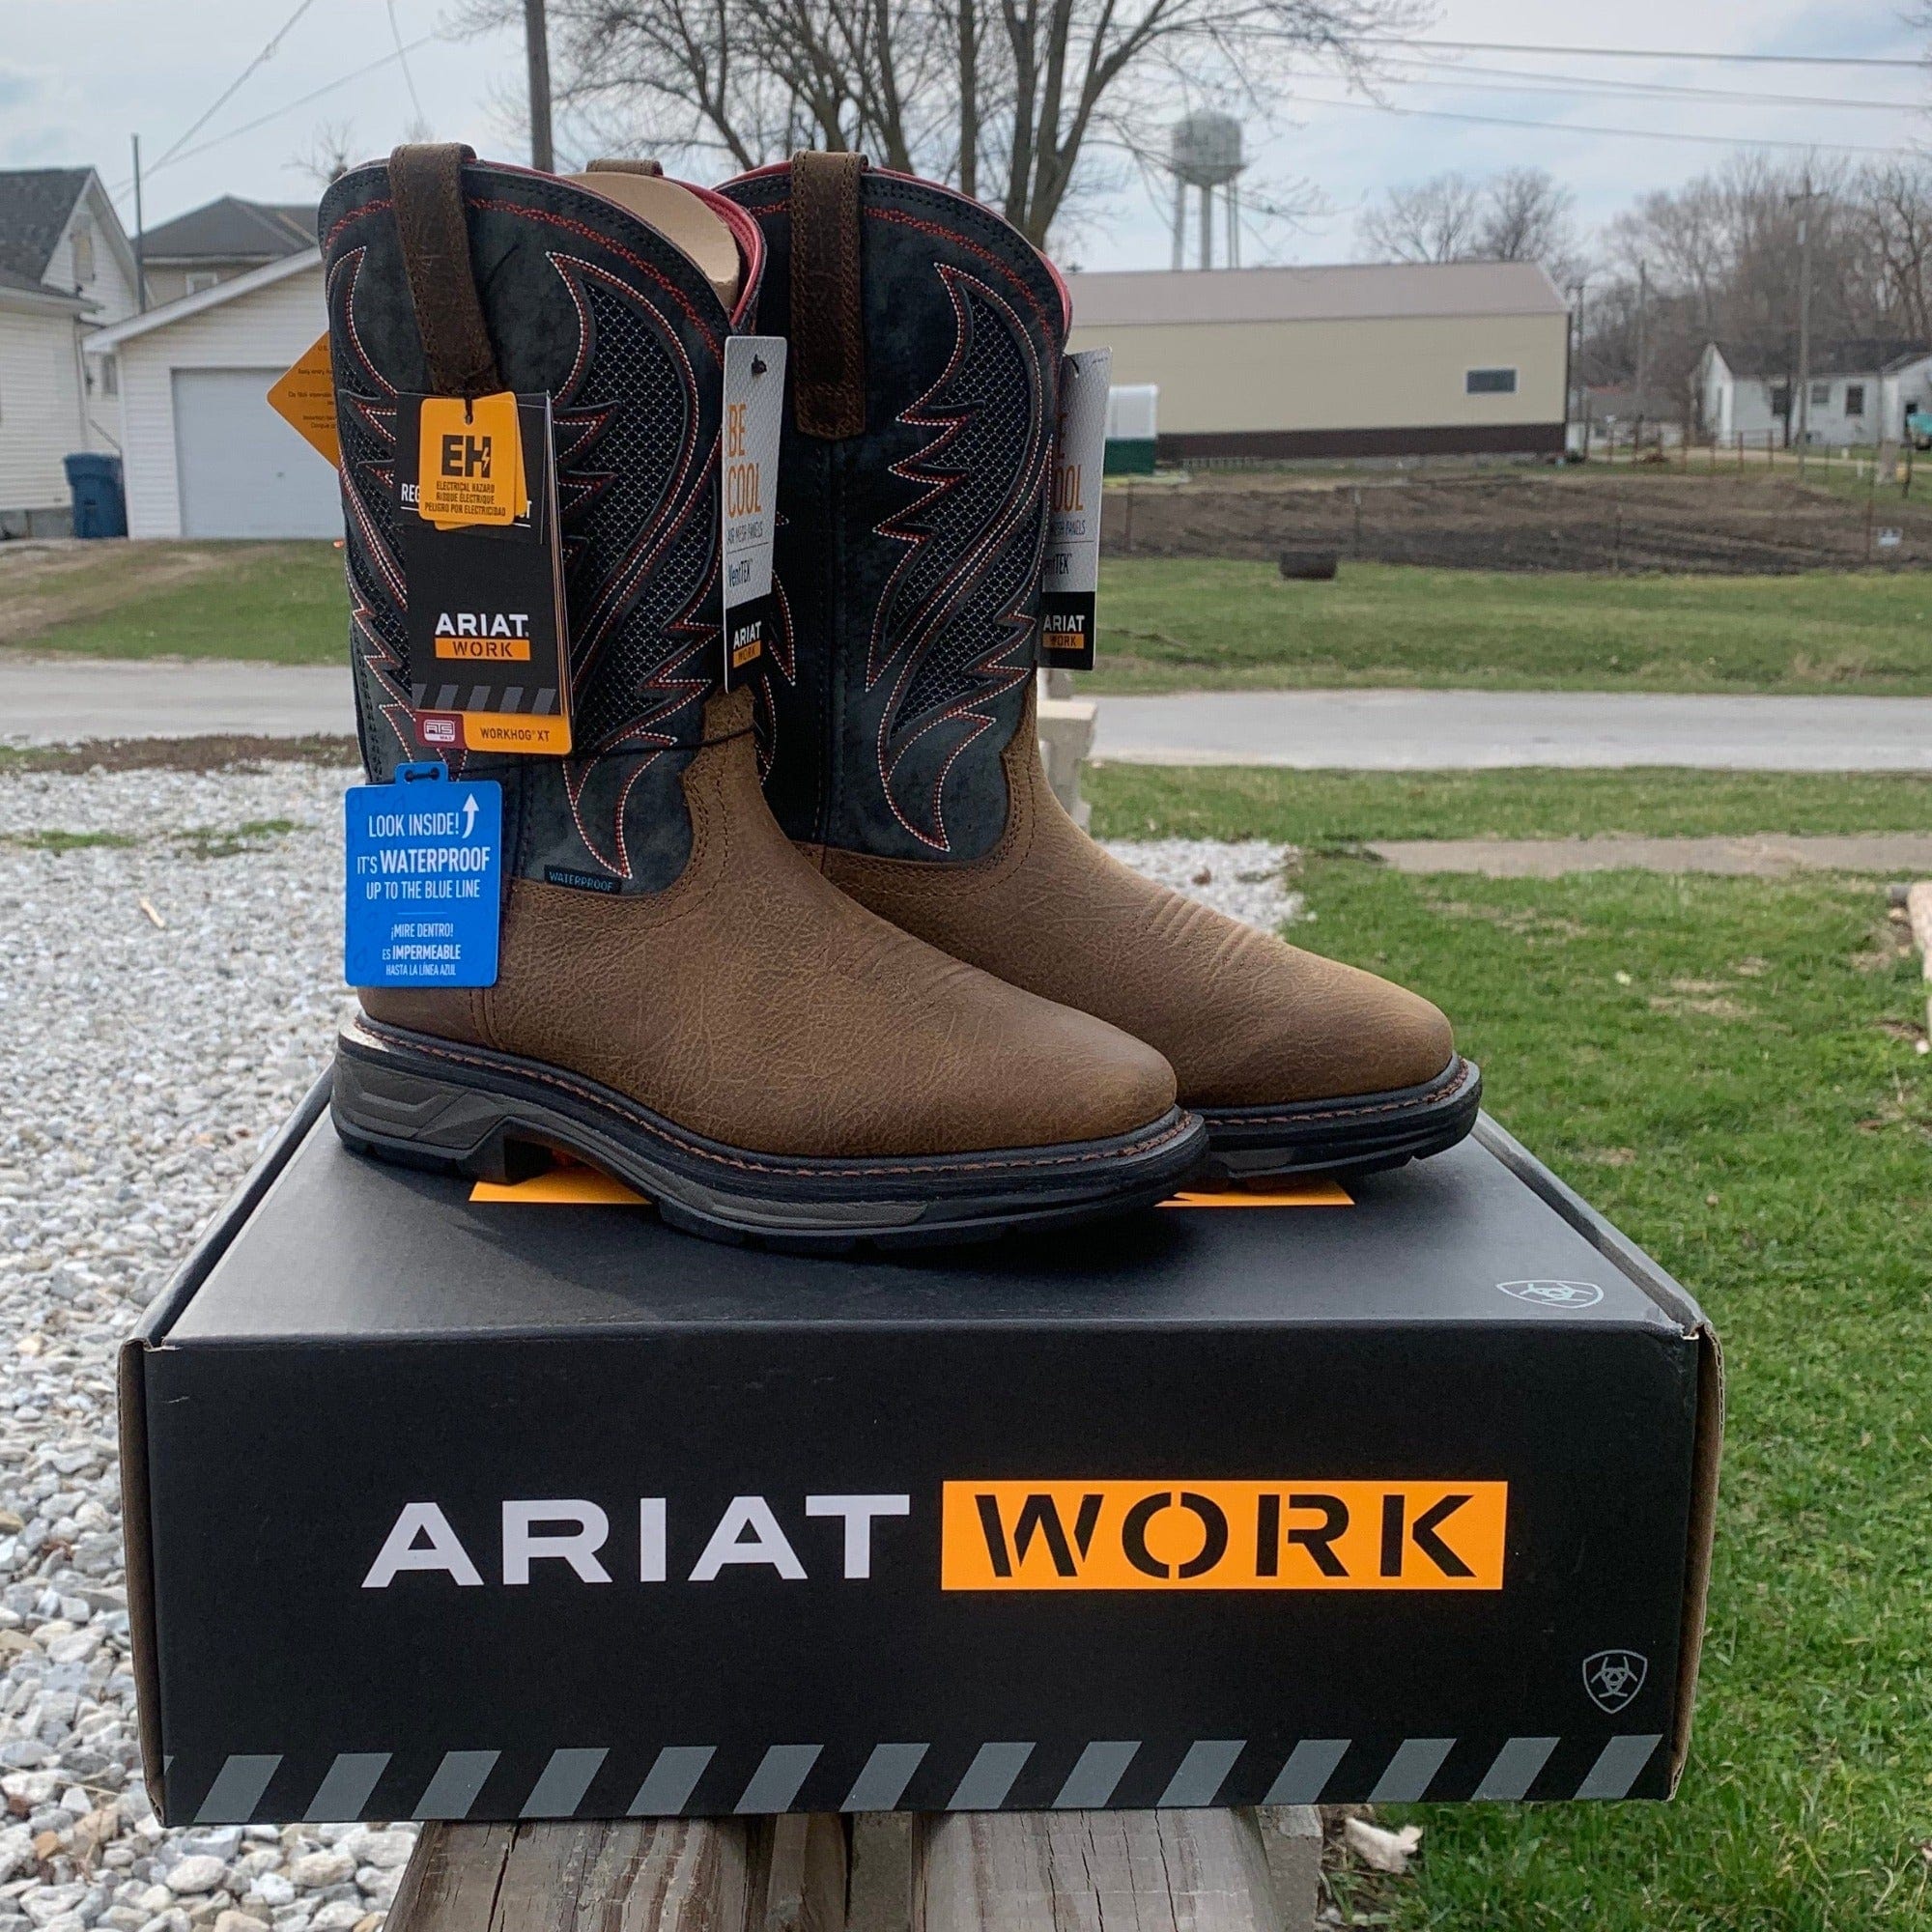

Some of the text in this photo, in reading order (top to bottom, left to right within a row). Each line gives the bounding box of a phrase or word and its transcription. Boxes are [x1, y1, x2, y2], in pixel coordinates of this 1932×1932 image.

[727, 403, 747, 457] BE
[441, 434, 492, 478] EH
[436, 481, 496, 494] ELECTRICAL HAZARD
[436, 493, 458, 502] RISQUE
[727, 462, 761, 518] COOL
[1052, 465, 1084, 512] OOL
[425, 502, 449, 513] PELIGRO
[450, 503, 464, 513] POR
[465, 505, 506, 517] ELECTRICIDAD
[435, 612, 528, 638] ARIAT
[1043, 614, 1085, 632] ARIAT
[733, 620, 762, 650] ARIAT
[1050, 636, 1076, 647] WORK
[452, 641, 514, 658] WORK
[537, 729, 550, 742] XT
[368, 812, 460, 838] LOOK INSIDE!
[357, 847, 491, 874] IT'S WATERPROOF
[366, 879, 480, 899] UP TO THE BLUE LINE
[549, 871, 614, 892] WATERPROOF
[416, 923, 454, 937] DENTRO!
[382, 944, 462, 959] ES IMPERMEABLE
[385, 964, 408, 976] HASTA
[409, 964, 418, 976] LA
[440, 964, 456, 975] AZUL
[360, 1494, 910, 1588] ARIAT
[975, 1492, 1477, 1579] WORK
